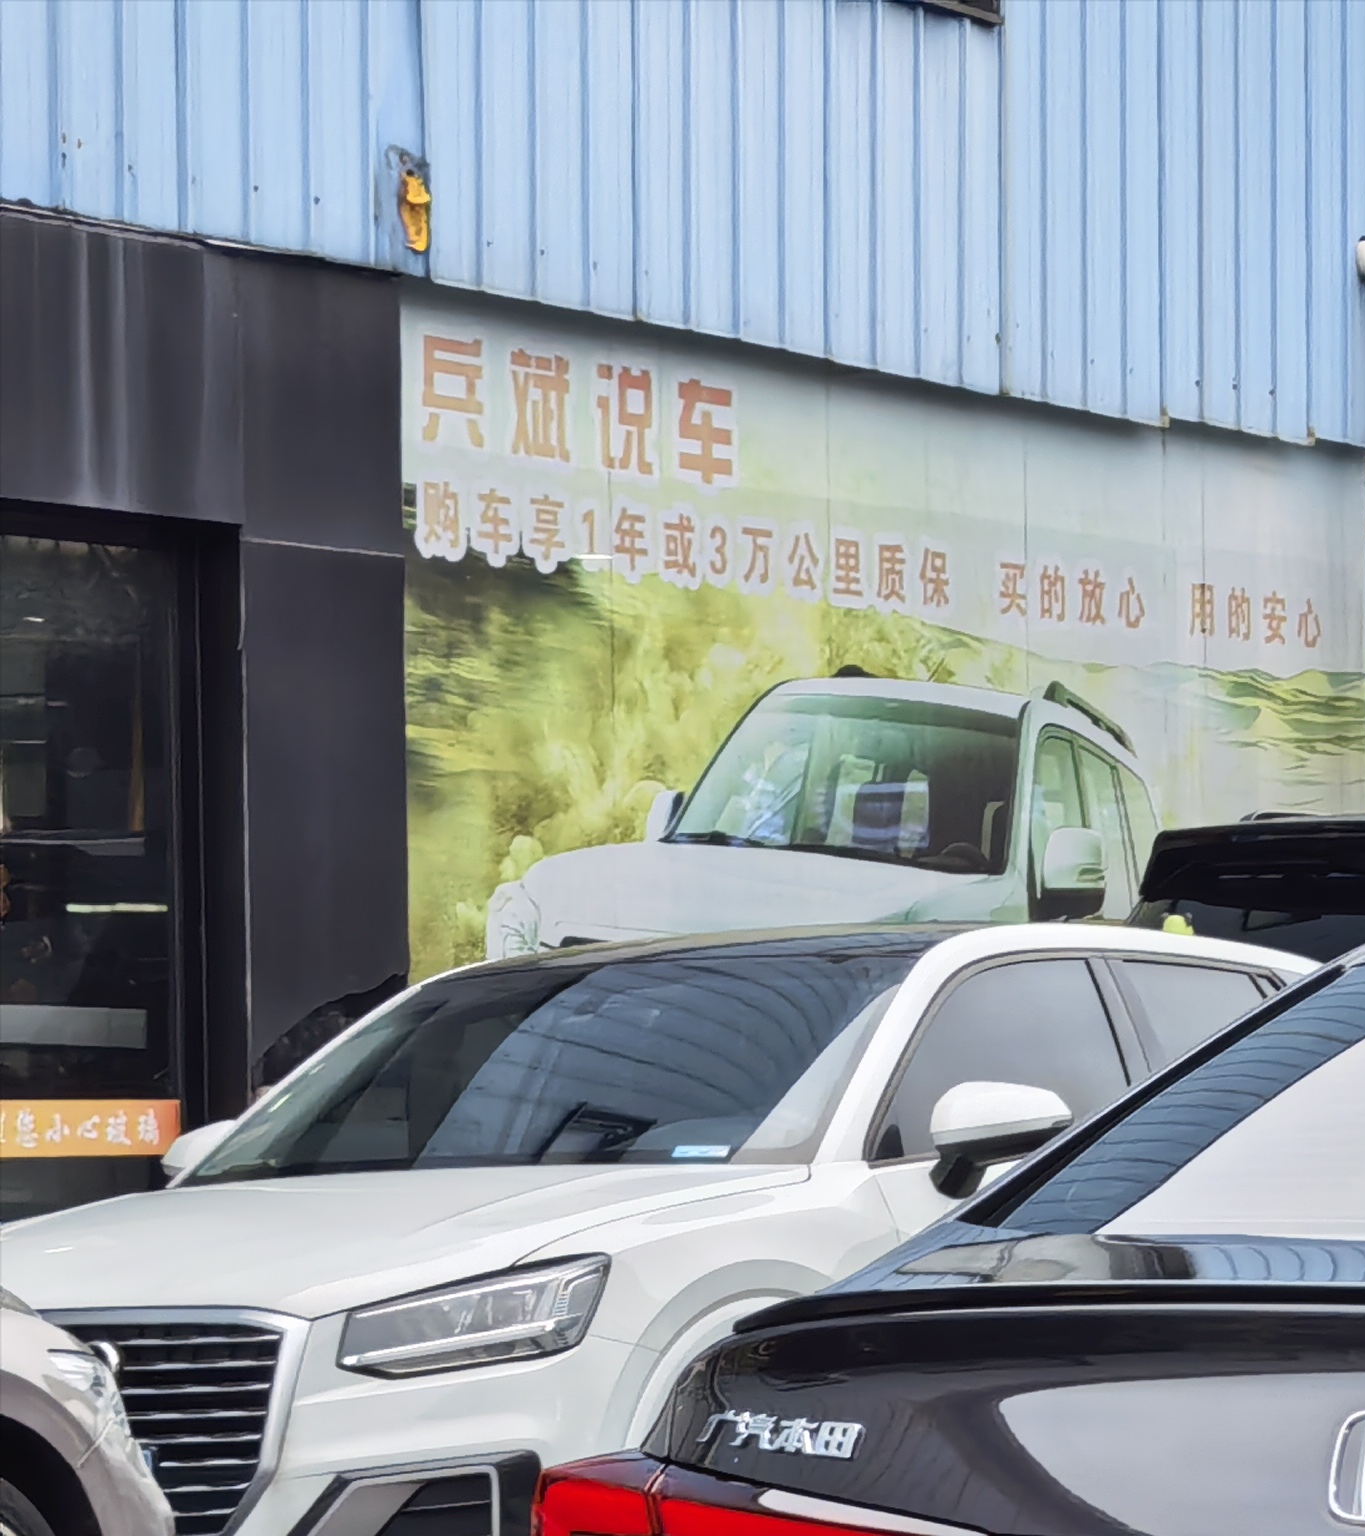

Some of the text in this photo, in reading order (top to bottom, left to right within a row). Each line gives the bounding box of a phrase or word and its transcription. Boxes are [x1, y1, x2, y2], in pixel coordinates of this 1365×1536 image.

[422, 334, 733, 485] 兵斌说车
[423, 481, 1322, 649] 购车享1年或3万公里质保 买的放心 用的安心
[0, 1108, 160, 1148] 您小心玻璃
[696, 1410, 866, 1459] 广汽本田
